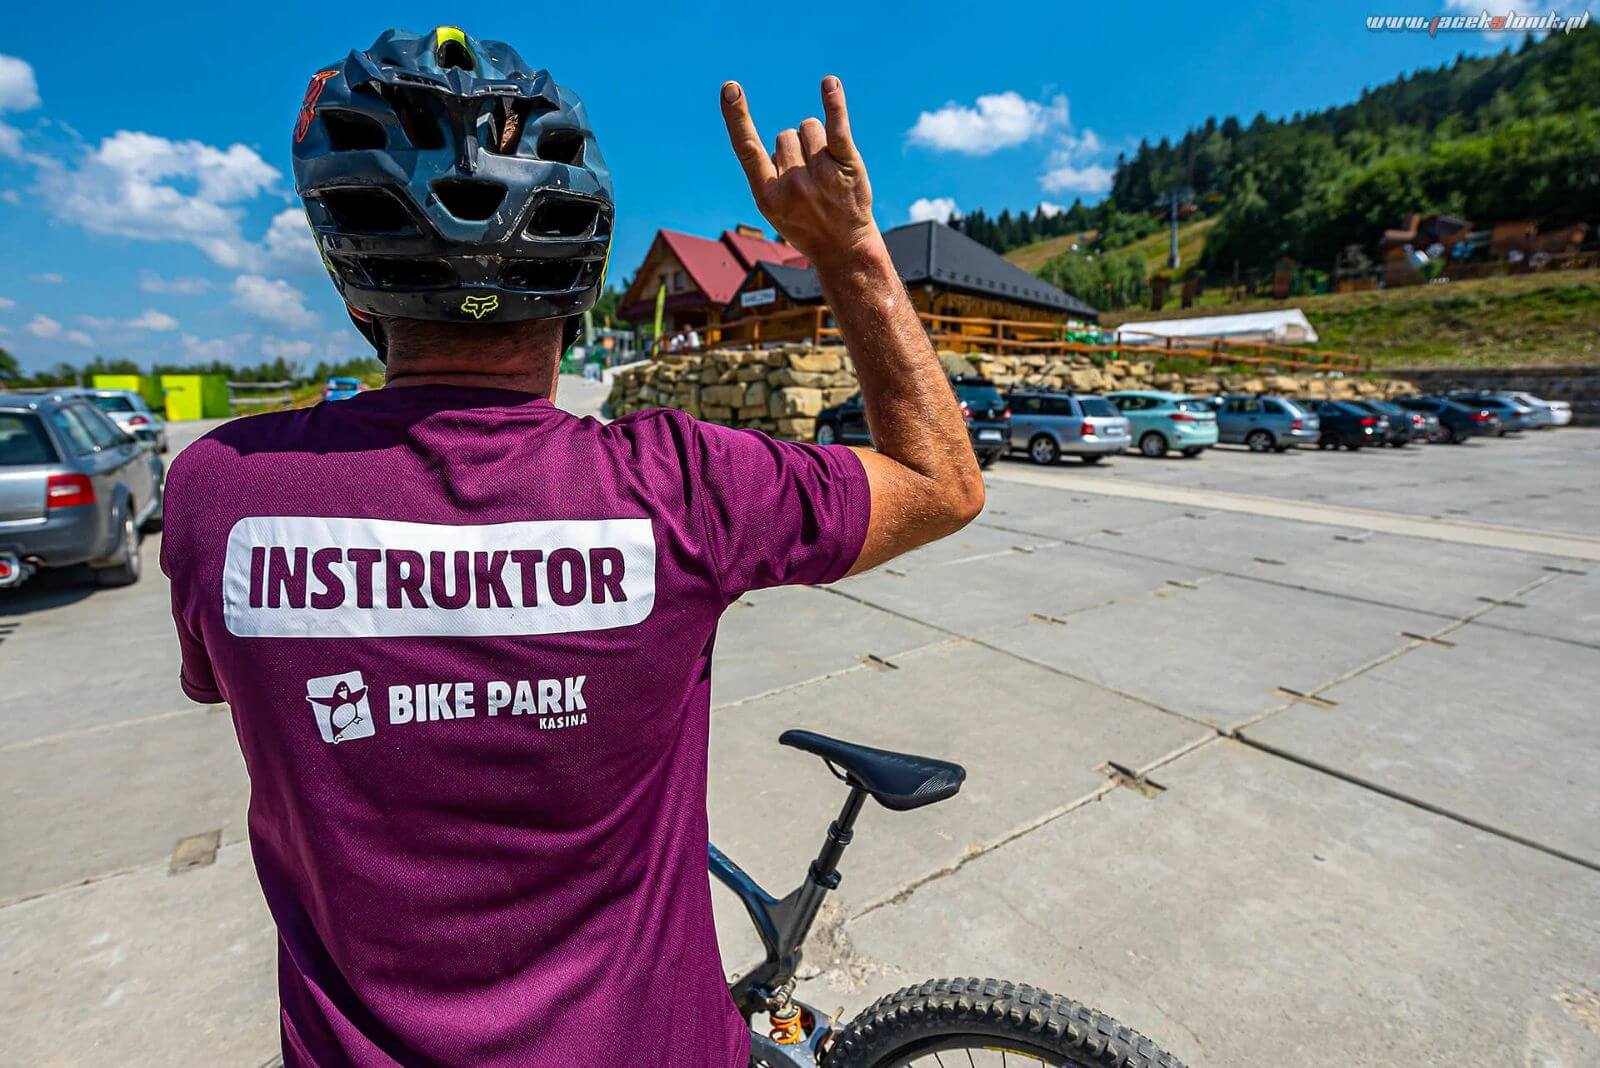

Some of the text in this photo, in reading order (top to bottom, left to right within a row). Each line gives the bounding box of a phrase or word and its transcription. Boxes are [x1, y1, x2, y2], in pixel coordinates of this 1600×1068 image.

[249, 546, 628, 610] INSTRUKTOR
[388, 675, 587, 725] BIKE PARK
[539, 713, 588, 730] KASINA
